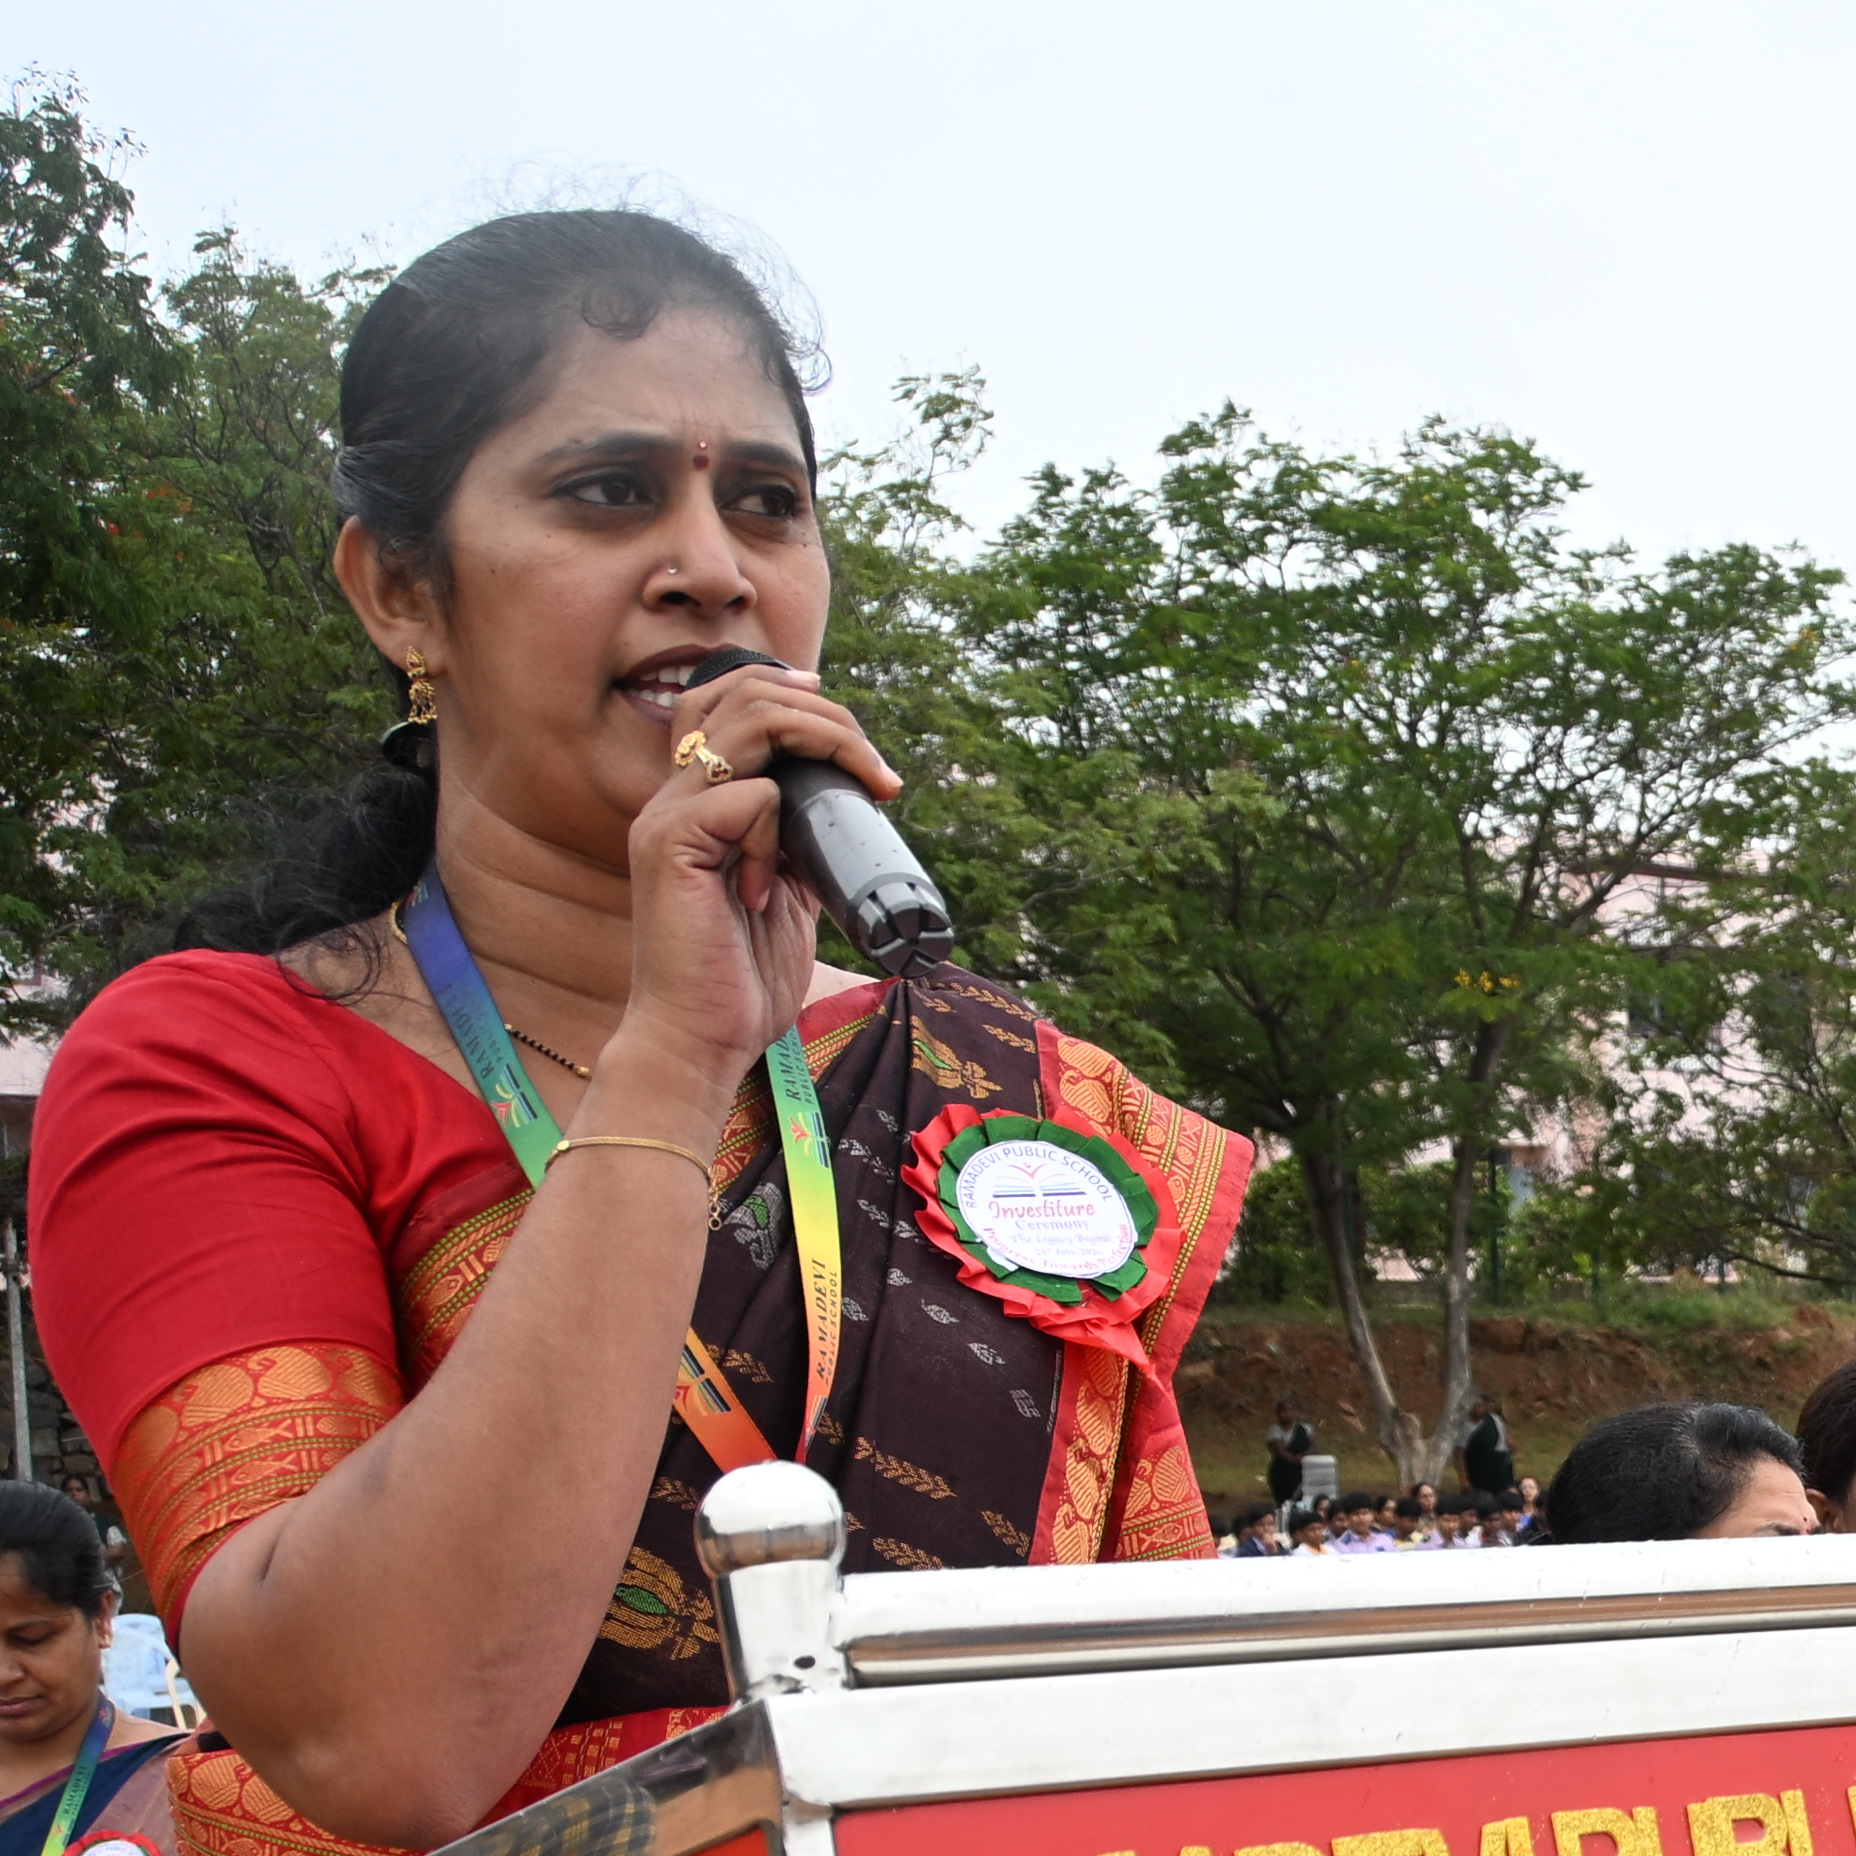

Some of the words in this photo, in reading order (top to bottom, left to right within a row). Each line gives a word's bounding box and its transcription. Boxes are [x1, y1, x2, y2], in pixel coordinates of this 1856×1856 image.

[775, 1036, 802, 1102] RAMAD
[962, 1151, 1002, 1209] RAMADEVI
[1002, 1145, 1058, 1162] PUBLIC
[1060, 1155, 1114, 1203] SCHOOL
[988, 1199, 1096, 1219] Investiture
[1015, 1219, 1090, 1231] Ceremony
[810, 1257, 828, 1381] RAMADEVI
[829, 1271, 838, 1329] SCHOOL
